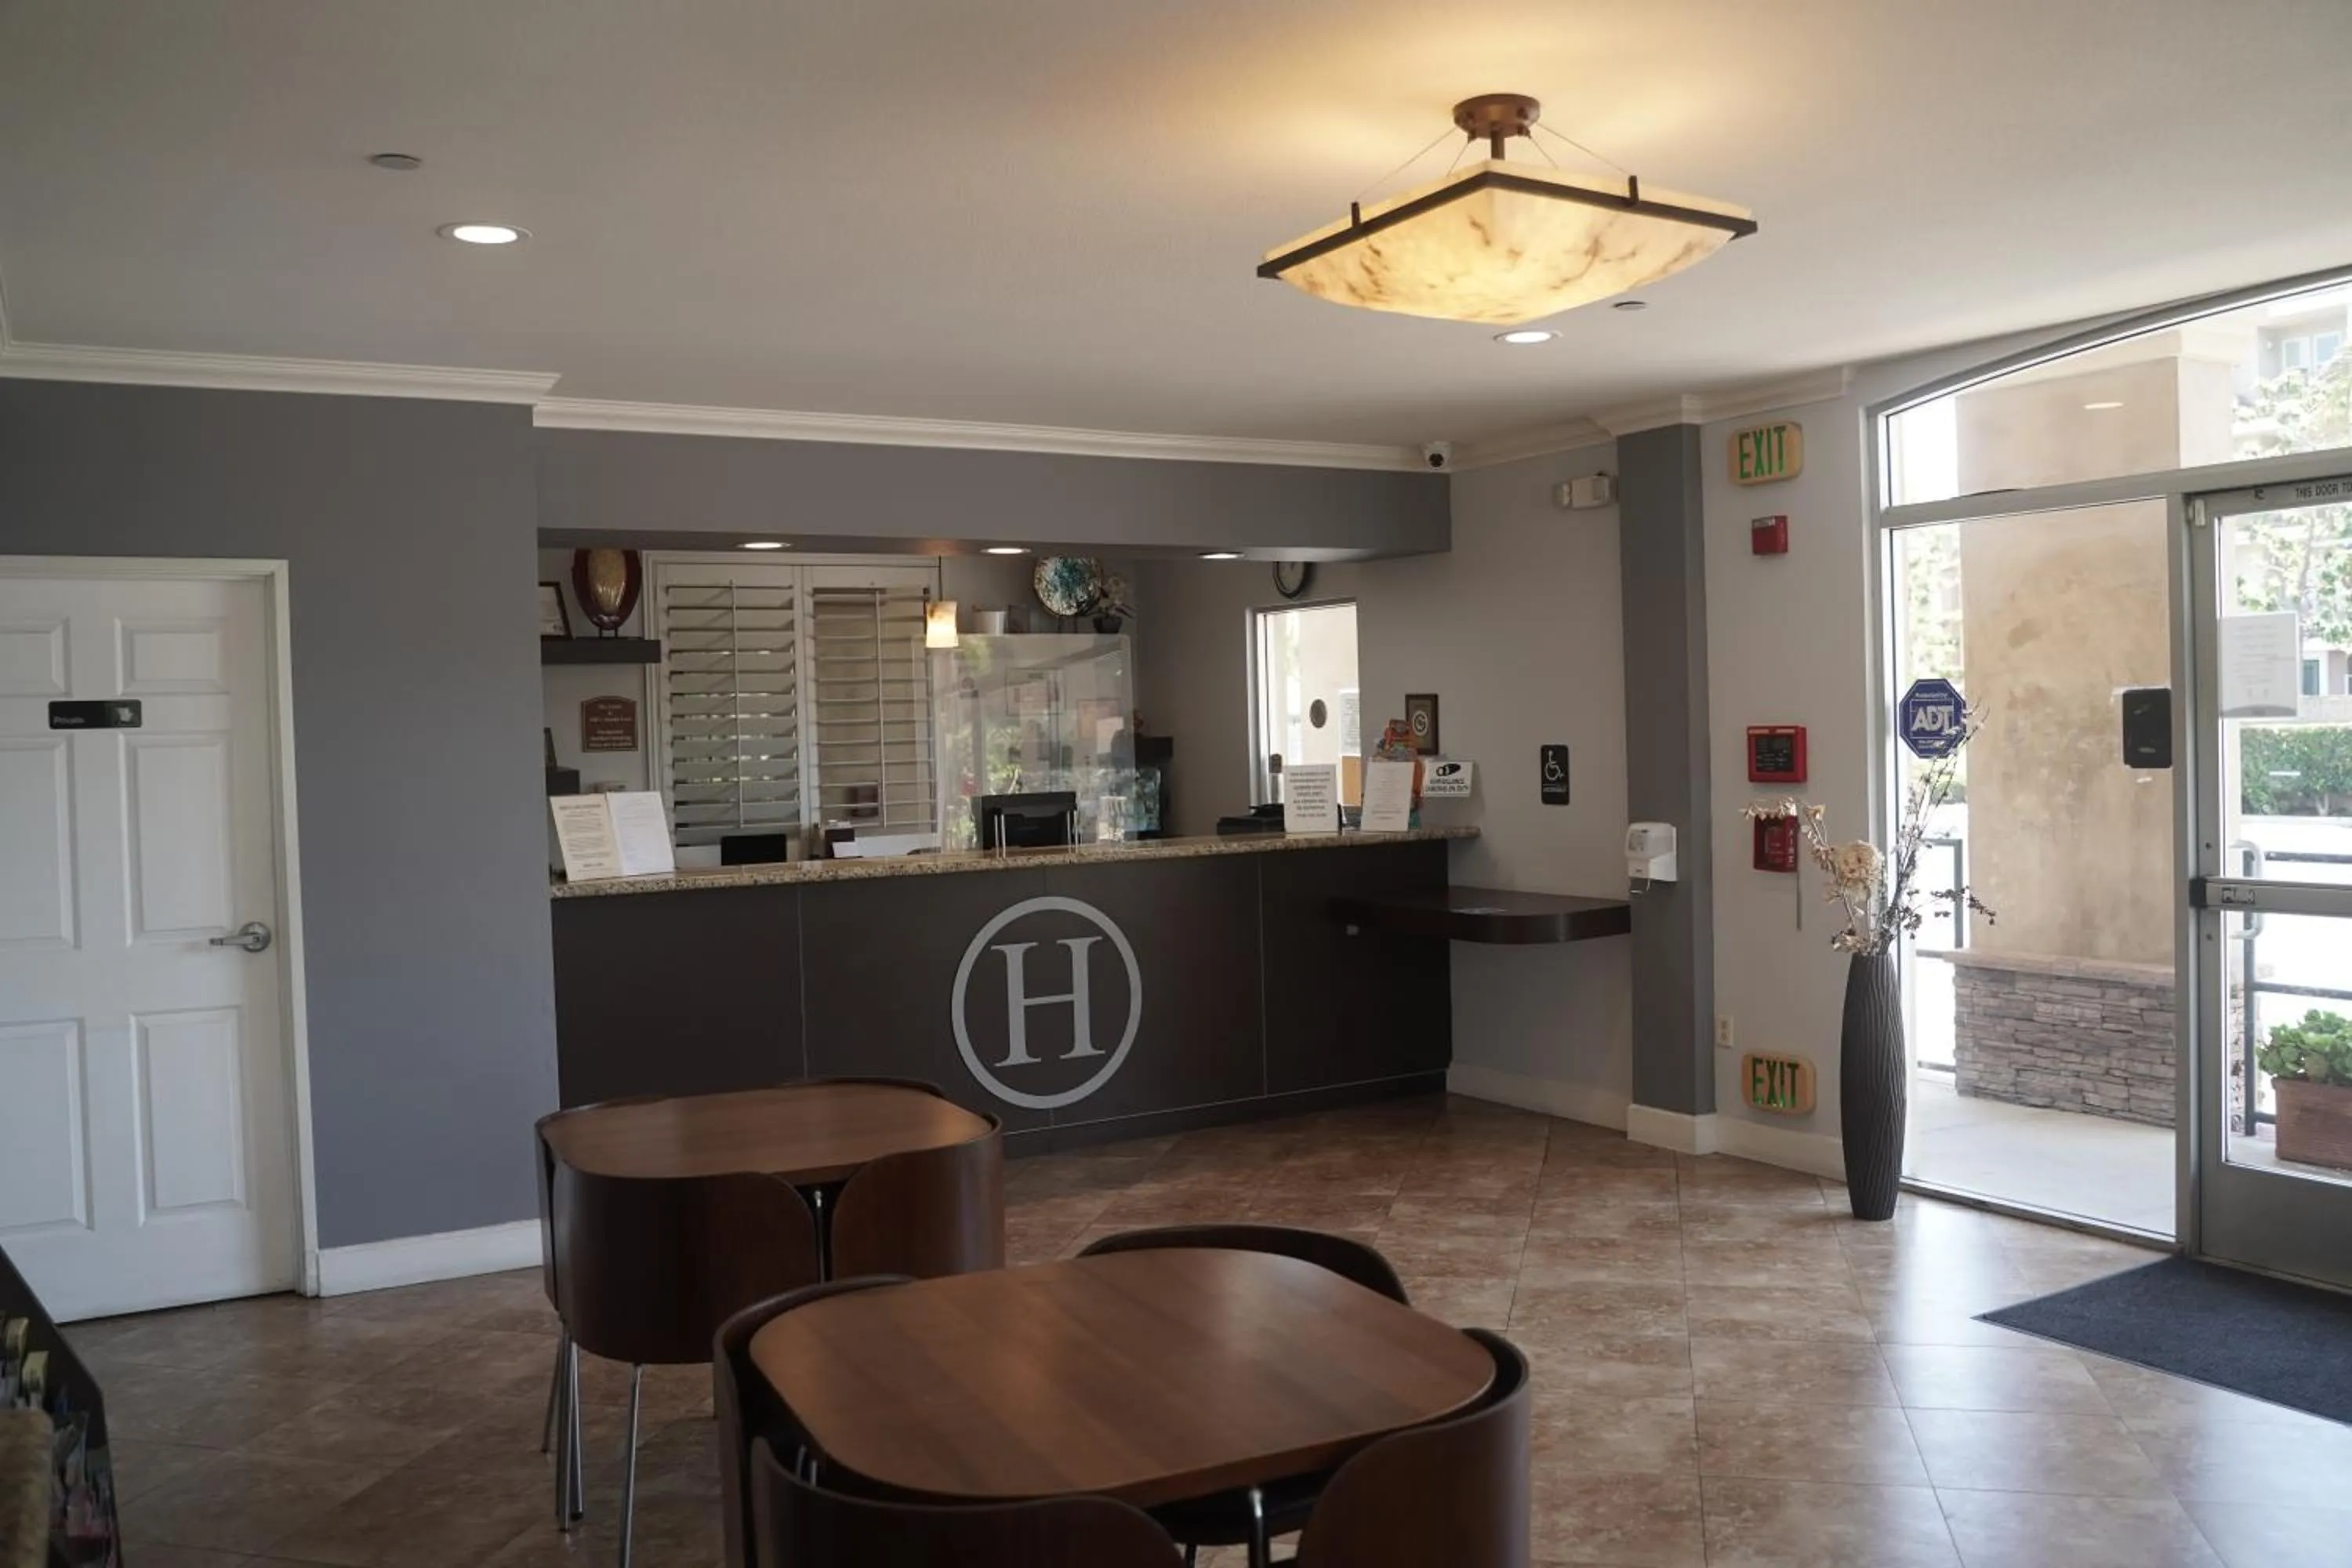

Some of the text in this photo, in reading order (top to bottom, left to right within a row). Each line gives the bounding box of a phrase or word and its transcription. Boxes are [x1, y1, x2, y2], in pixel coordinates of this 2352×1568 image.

[1738, 426, 1787, 479] EXIT
[2295, 487, 2312, 499] THIS
[1911, 705, 1955, 732] ADT
[990, 935, 1106, 1068] H
[1752, 1056, 1801, 1108] EXIT
